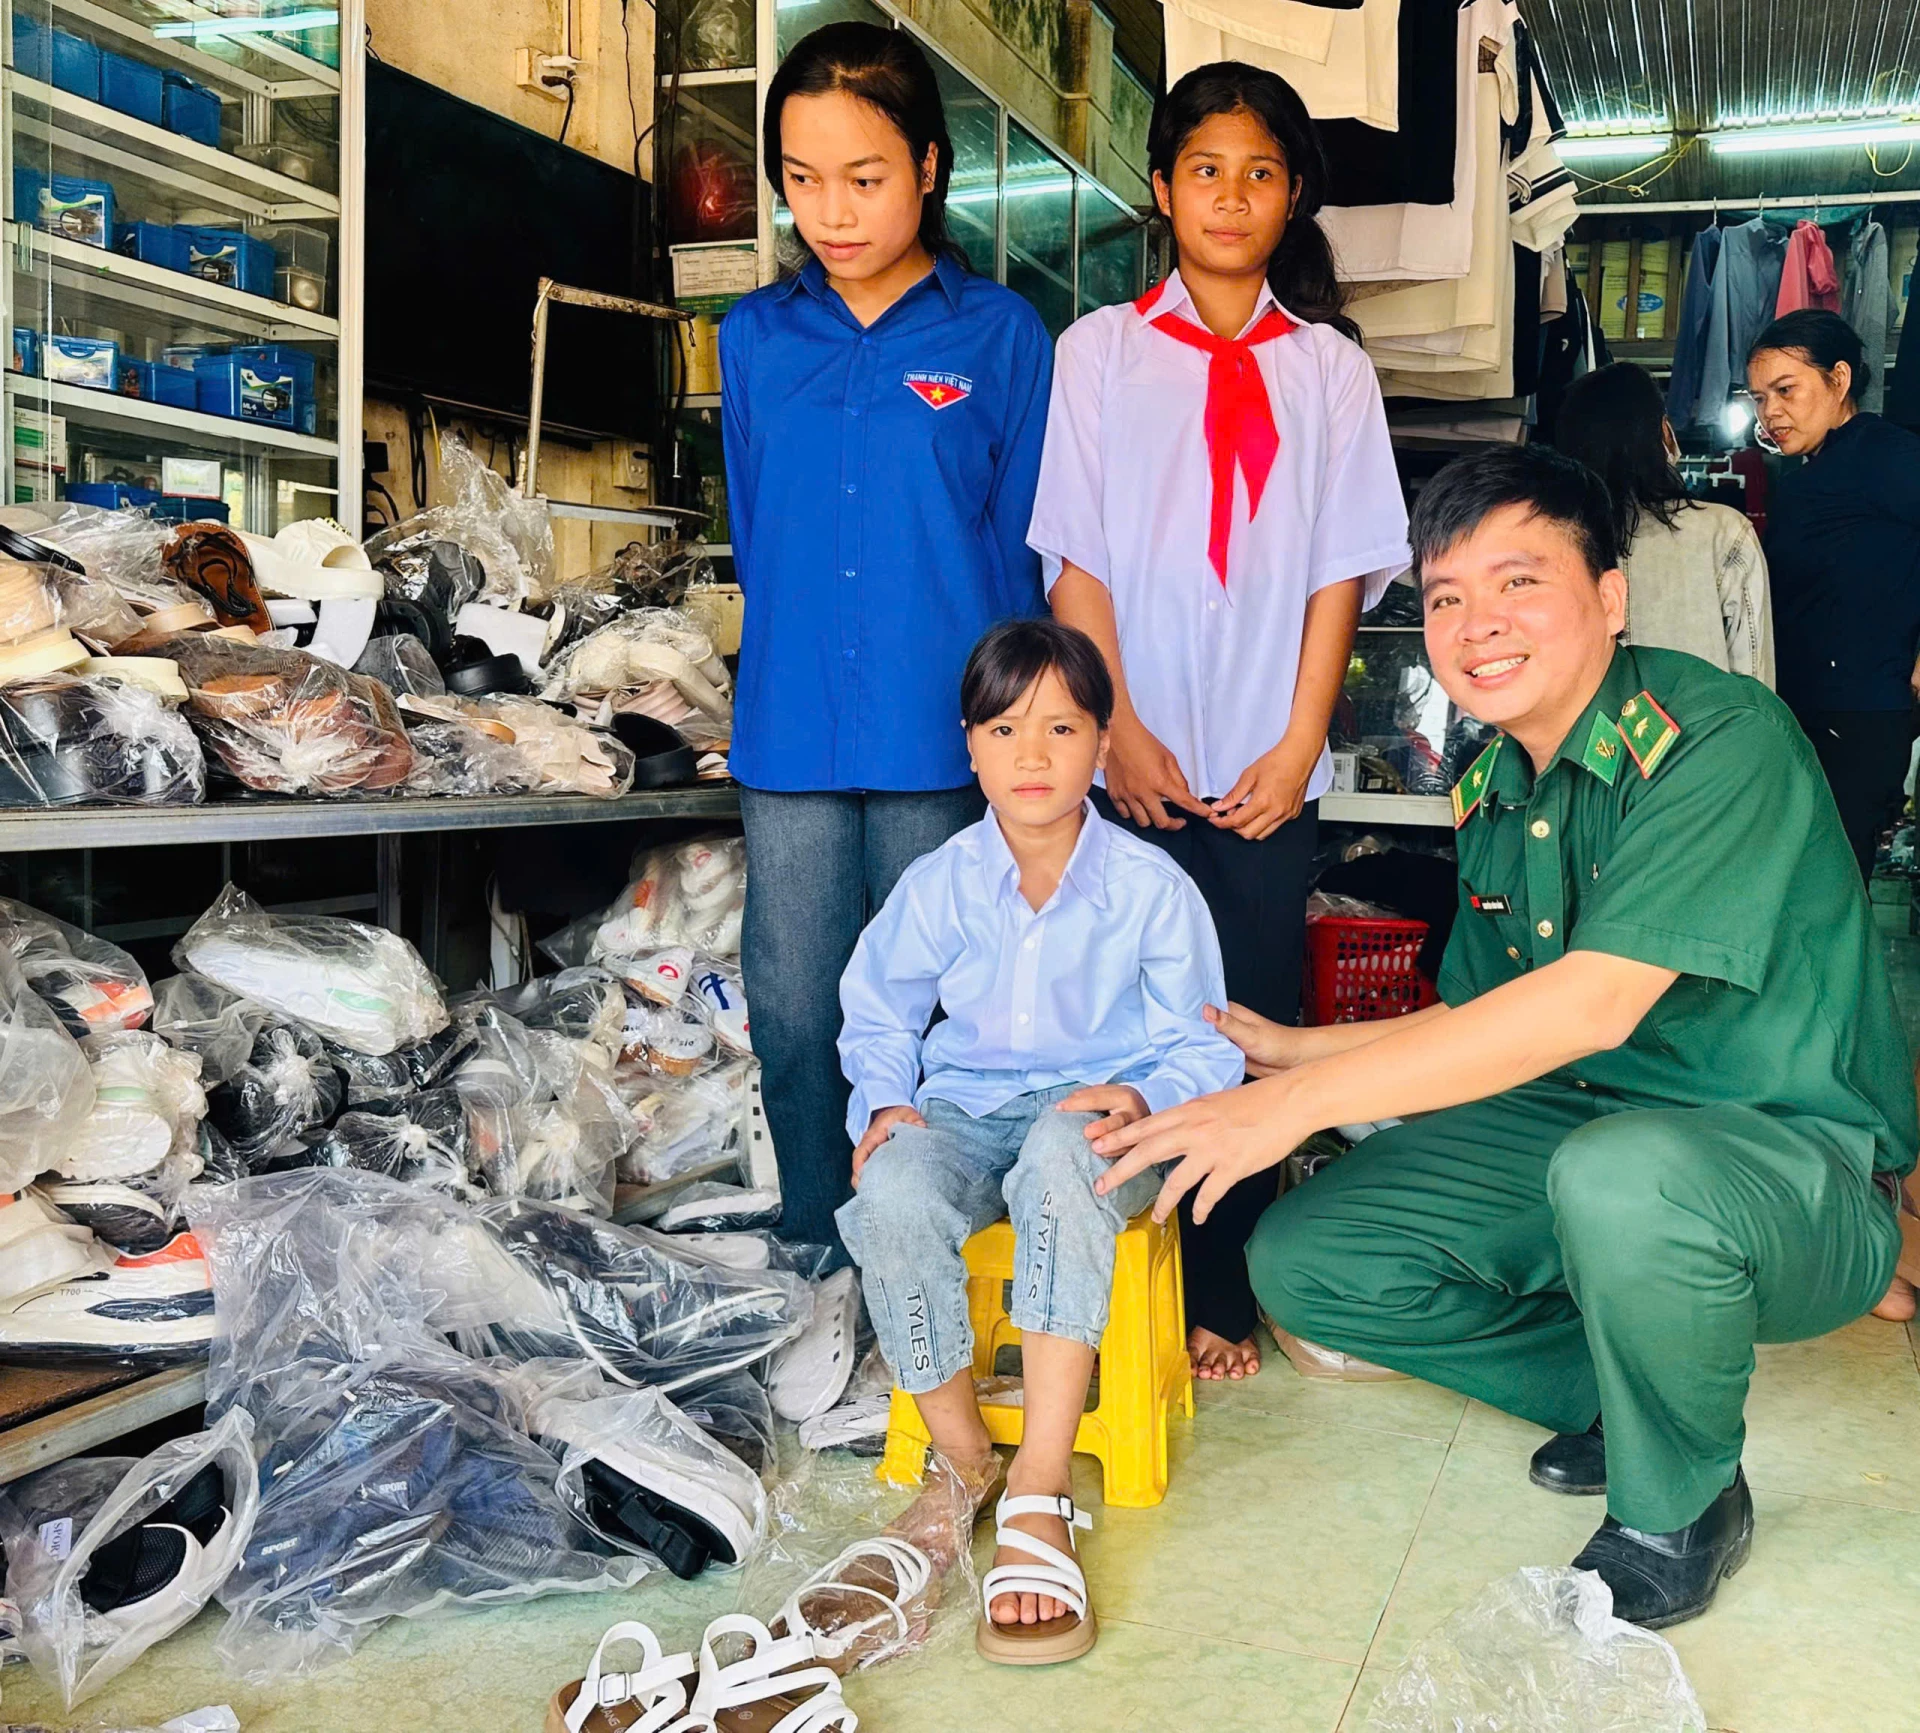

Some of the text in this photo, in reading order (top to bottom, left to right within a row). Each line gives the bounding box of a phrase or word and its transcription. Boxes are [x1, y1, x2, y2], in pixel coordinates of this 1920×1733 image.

[906, 373, 927, 382] THANH
[957, 380, 972, 394] NAM
[60, 1288, 81, 1296] T700
[906, 1282, 930, 1372] TYLES
[378, 1480, 408, 1493] SPORT
[260, 1537, 298, 1556] SPORT
